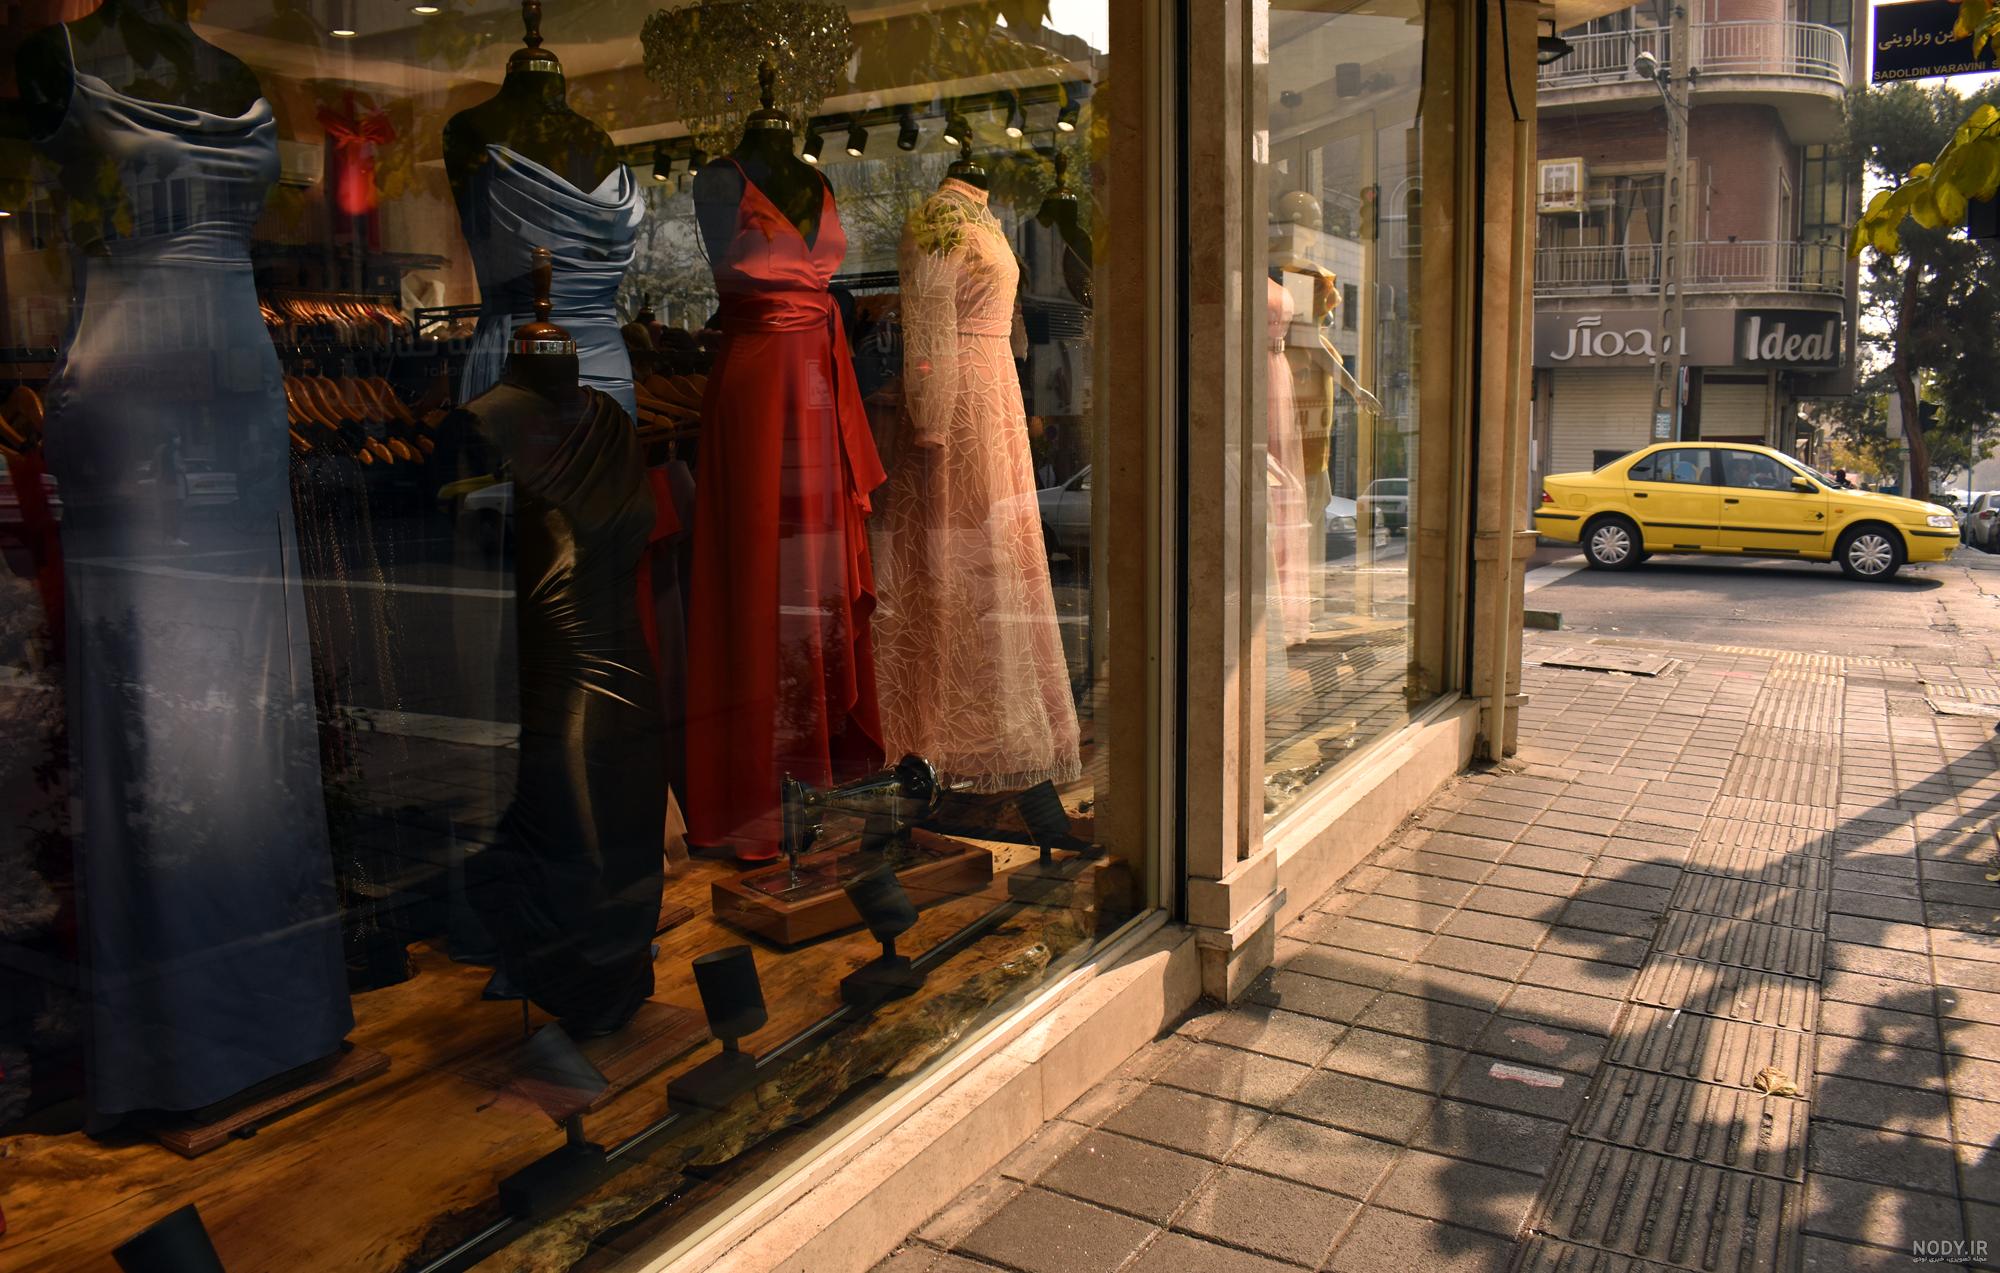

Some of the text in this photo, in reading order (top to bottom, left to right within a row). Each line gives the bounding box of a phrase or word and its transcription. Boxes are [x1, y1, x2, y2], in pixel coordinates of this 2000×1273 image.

[1878, 28, 1931, 50] وراوینی
[1874, 67, 1930, 79] SADOLDIN
[1934, 61, 1985, 73] VARAVINI
[1744, 315, 1834, 362] Ideal
